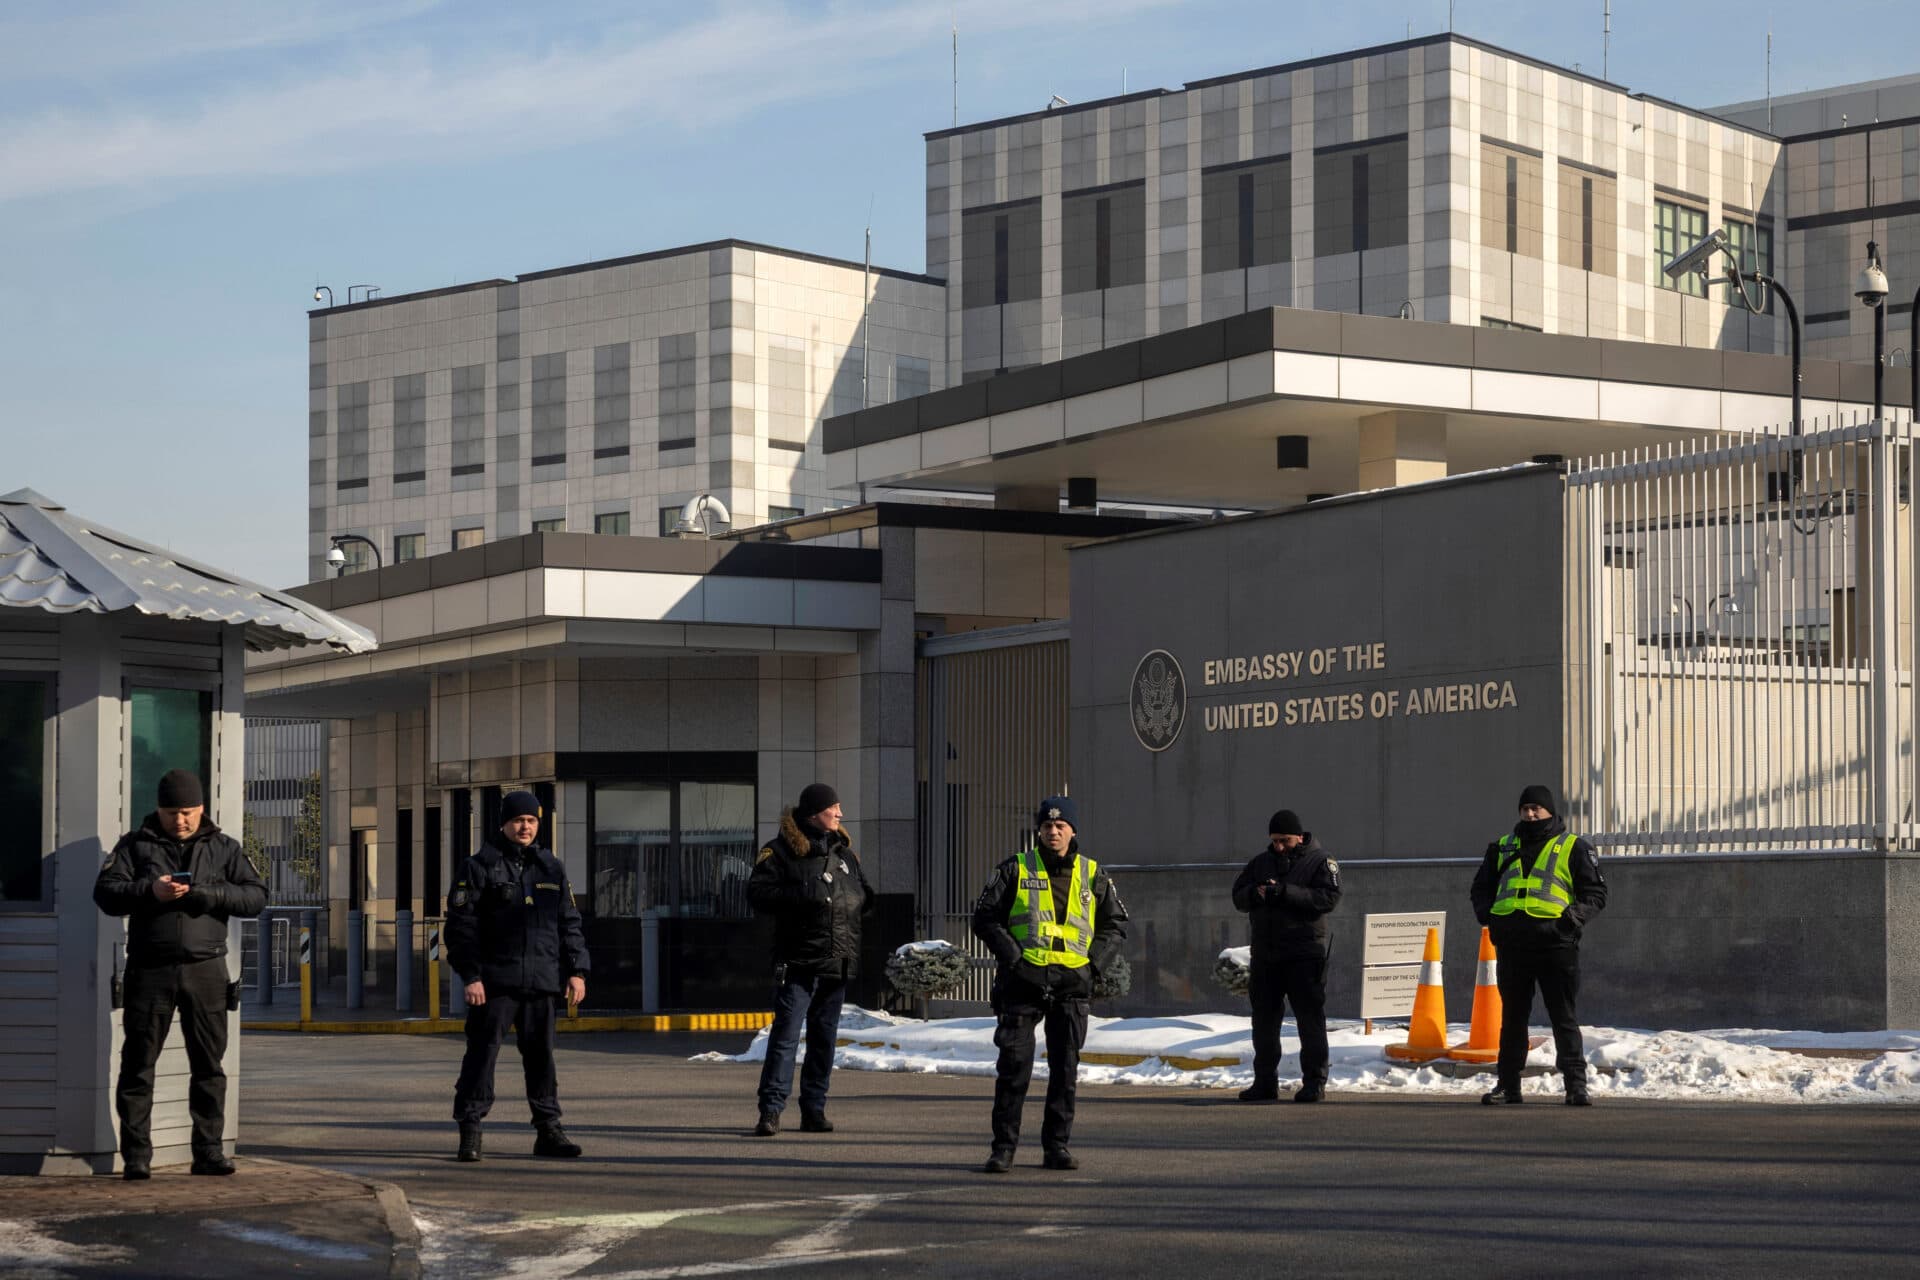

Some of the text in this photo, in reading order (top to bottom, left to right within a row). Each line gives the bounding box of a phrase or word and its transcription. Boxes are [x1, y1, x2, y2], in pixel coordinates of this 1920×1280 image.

[1204, 642, 1386, 686] EMBASSY OF THE
[1204, 680, 1519, 731] UNITED STATES OF AMERICA
